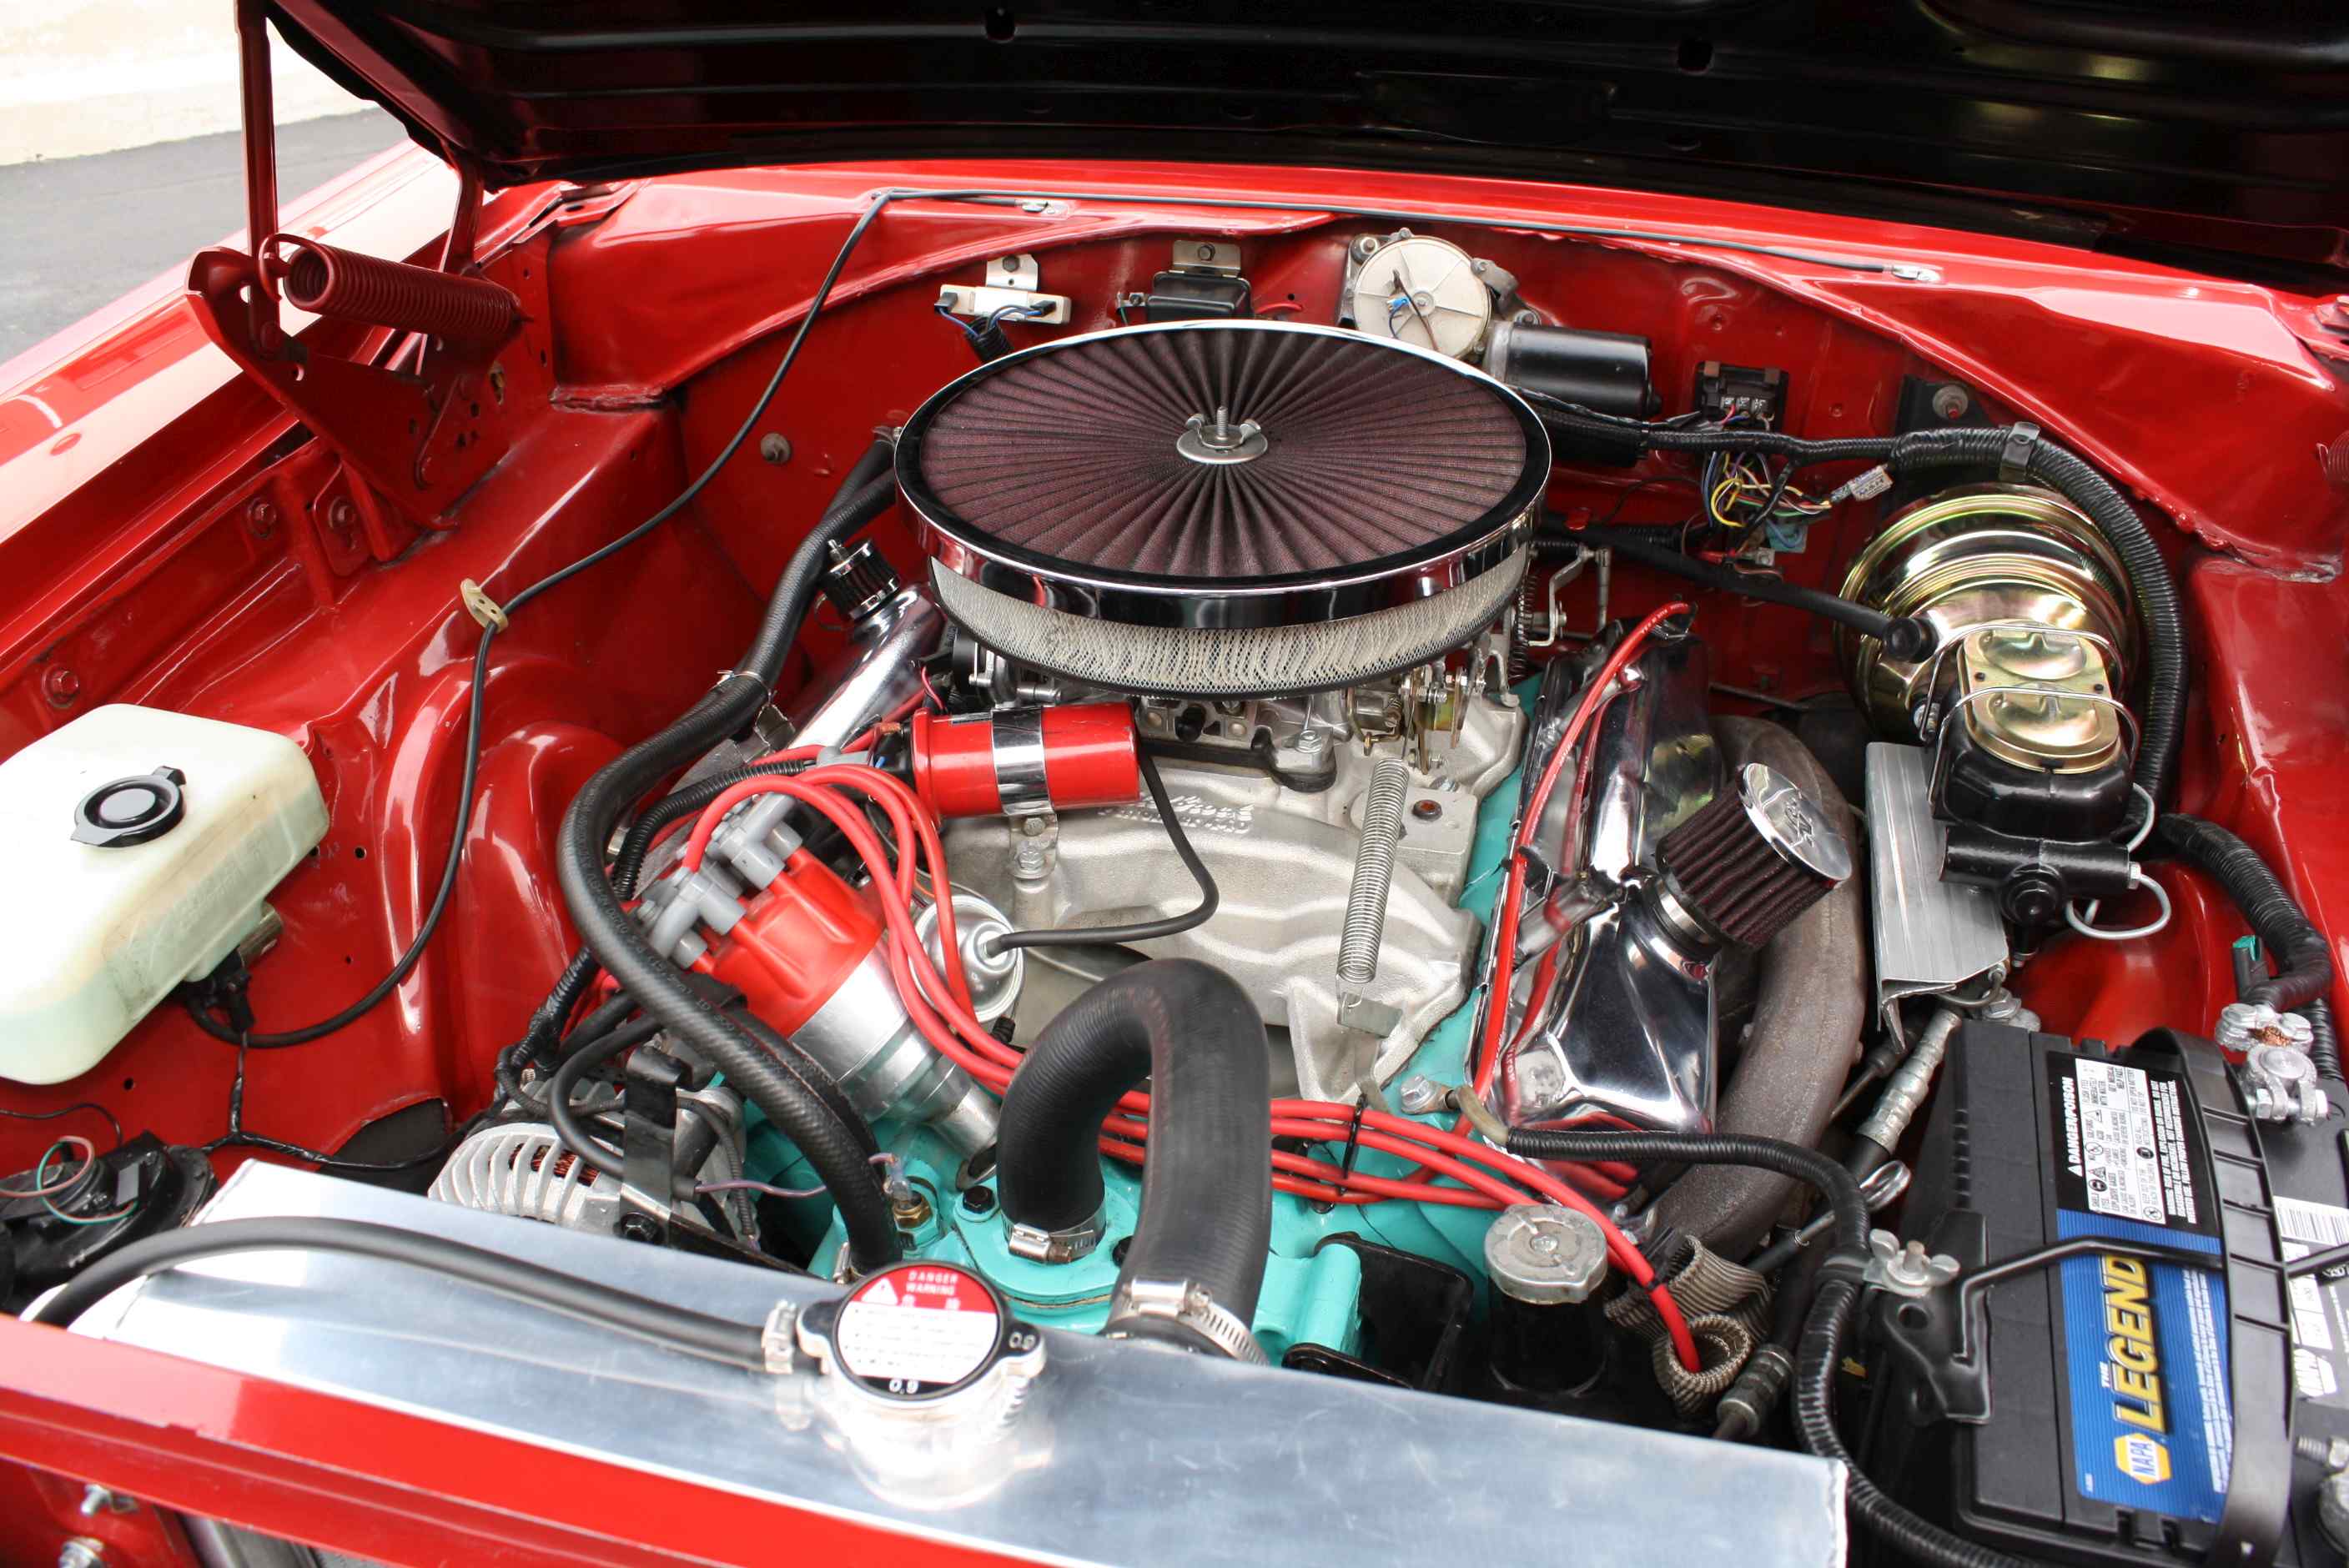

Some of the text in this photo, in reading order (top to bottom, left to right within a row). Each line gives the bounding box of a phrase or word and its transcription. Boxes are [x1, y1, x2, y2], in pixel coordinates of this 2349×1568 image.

[2062, 1077, 2081, 1164] DANGER/POISON
[905, 1282, 955, 1296] WARNING
[908, 1270, 958, 1284] DANGER
[2099, 1254, 2167, 1434] LEGEND
[888, 1379, 919, 1395] 0.9
[2099, 1361, 2110, 1388] THE
[2127, 1441, 2155, 1476] NAPA
